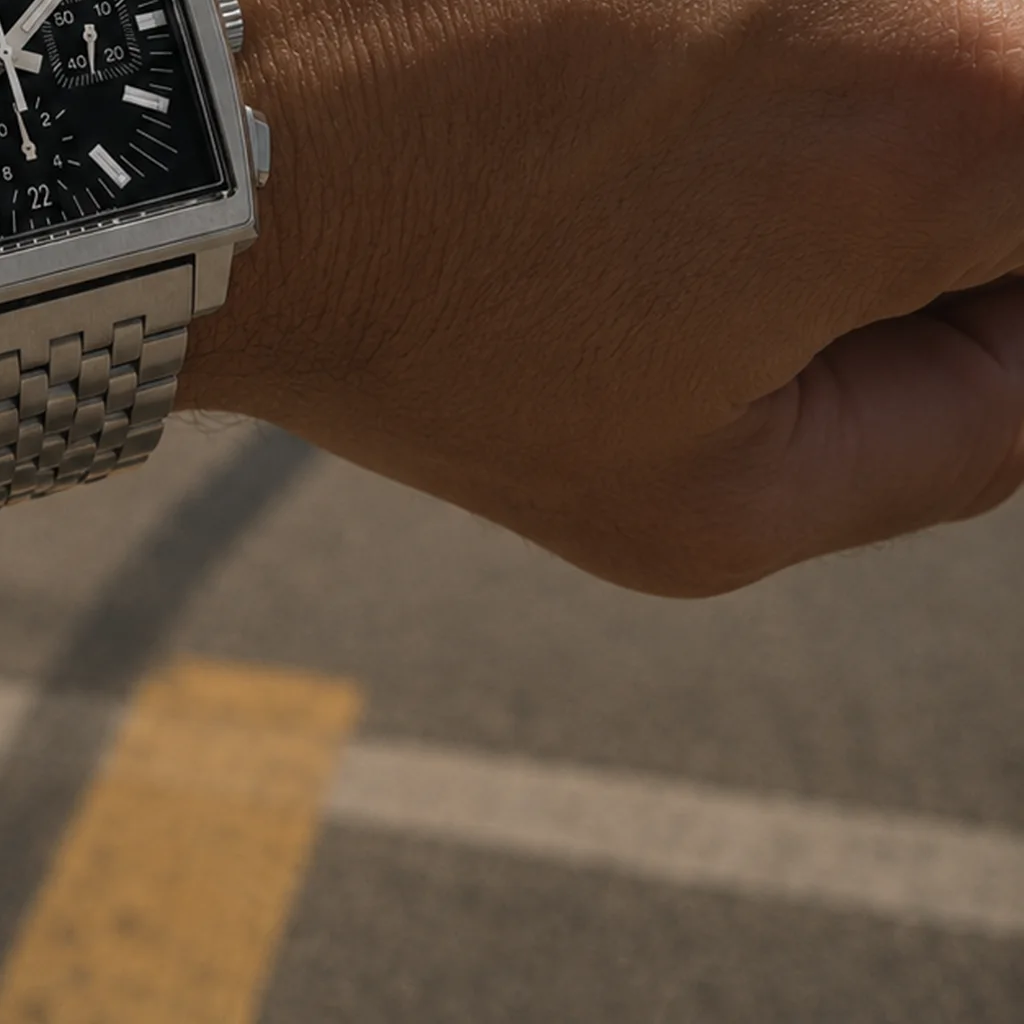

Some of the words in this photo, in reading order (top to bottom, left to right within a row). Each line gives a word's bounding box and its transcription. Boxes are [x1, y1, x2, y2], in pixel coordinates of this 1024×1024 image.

[93, 1, 112, 16] 10
[103, 45, 124, 63] 20
[67, 54, 87, 70] 40
[40, 112, 52, 127] 2
[53, 154, 63, 168] 4
[2, 166, 13, 181] 8
[27, 183, 53, 210] 22
